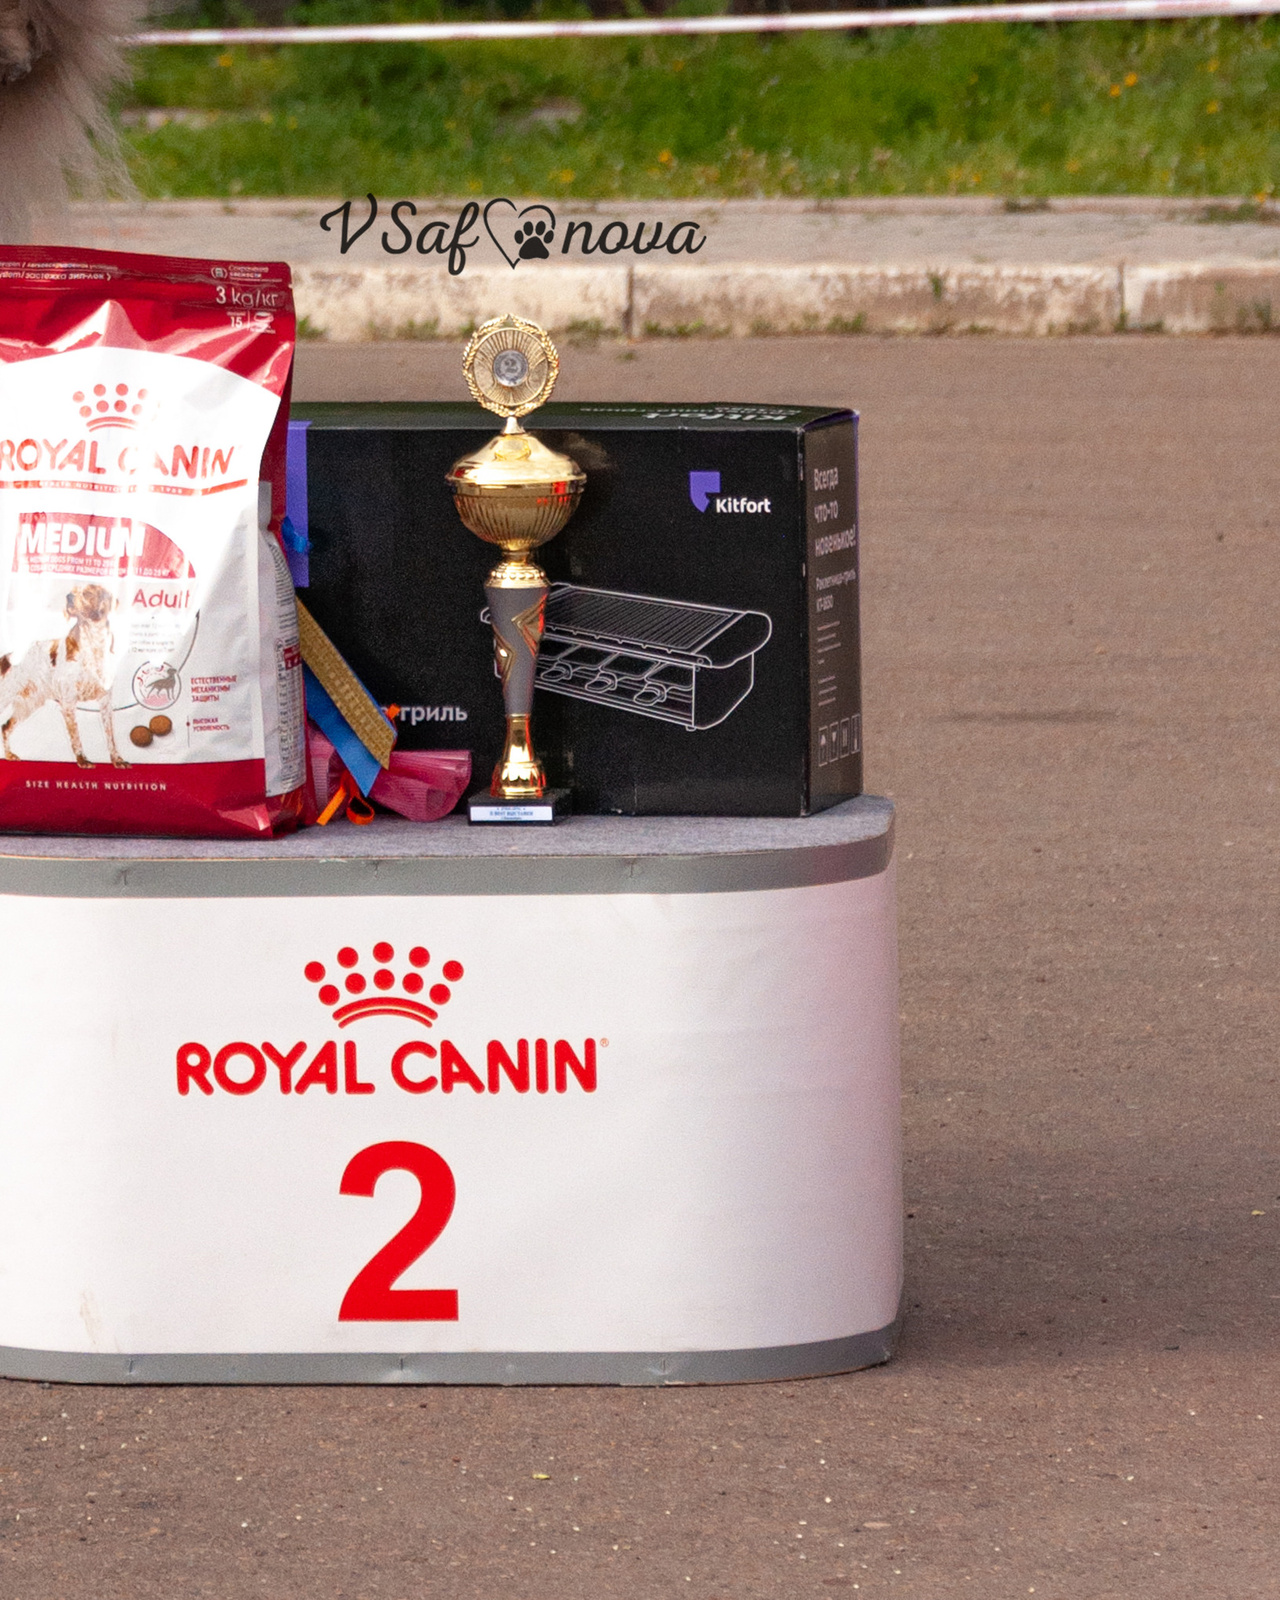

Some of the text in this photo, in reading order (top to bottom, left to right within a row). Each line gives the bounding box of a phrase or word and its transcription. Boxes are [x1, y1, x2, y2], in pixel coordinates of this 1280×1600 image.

[215, 285, 227, 304] 3
[813, 467, 839, 491] Всегда
[716, 498, 771, 514] Kitfort
[132, 589, 190, 608] Adult
[25, 780, 167, 792] SIZE HEALTH NUTRITION
[175, 1037, 598, 1096] ROYAL CANIN
[337, 1140, 460, 1323] 2
